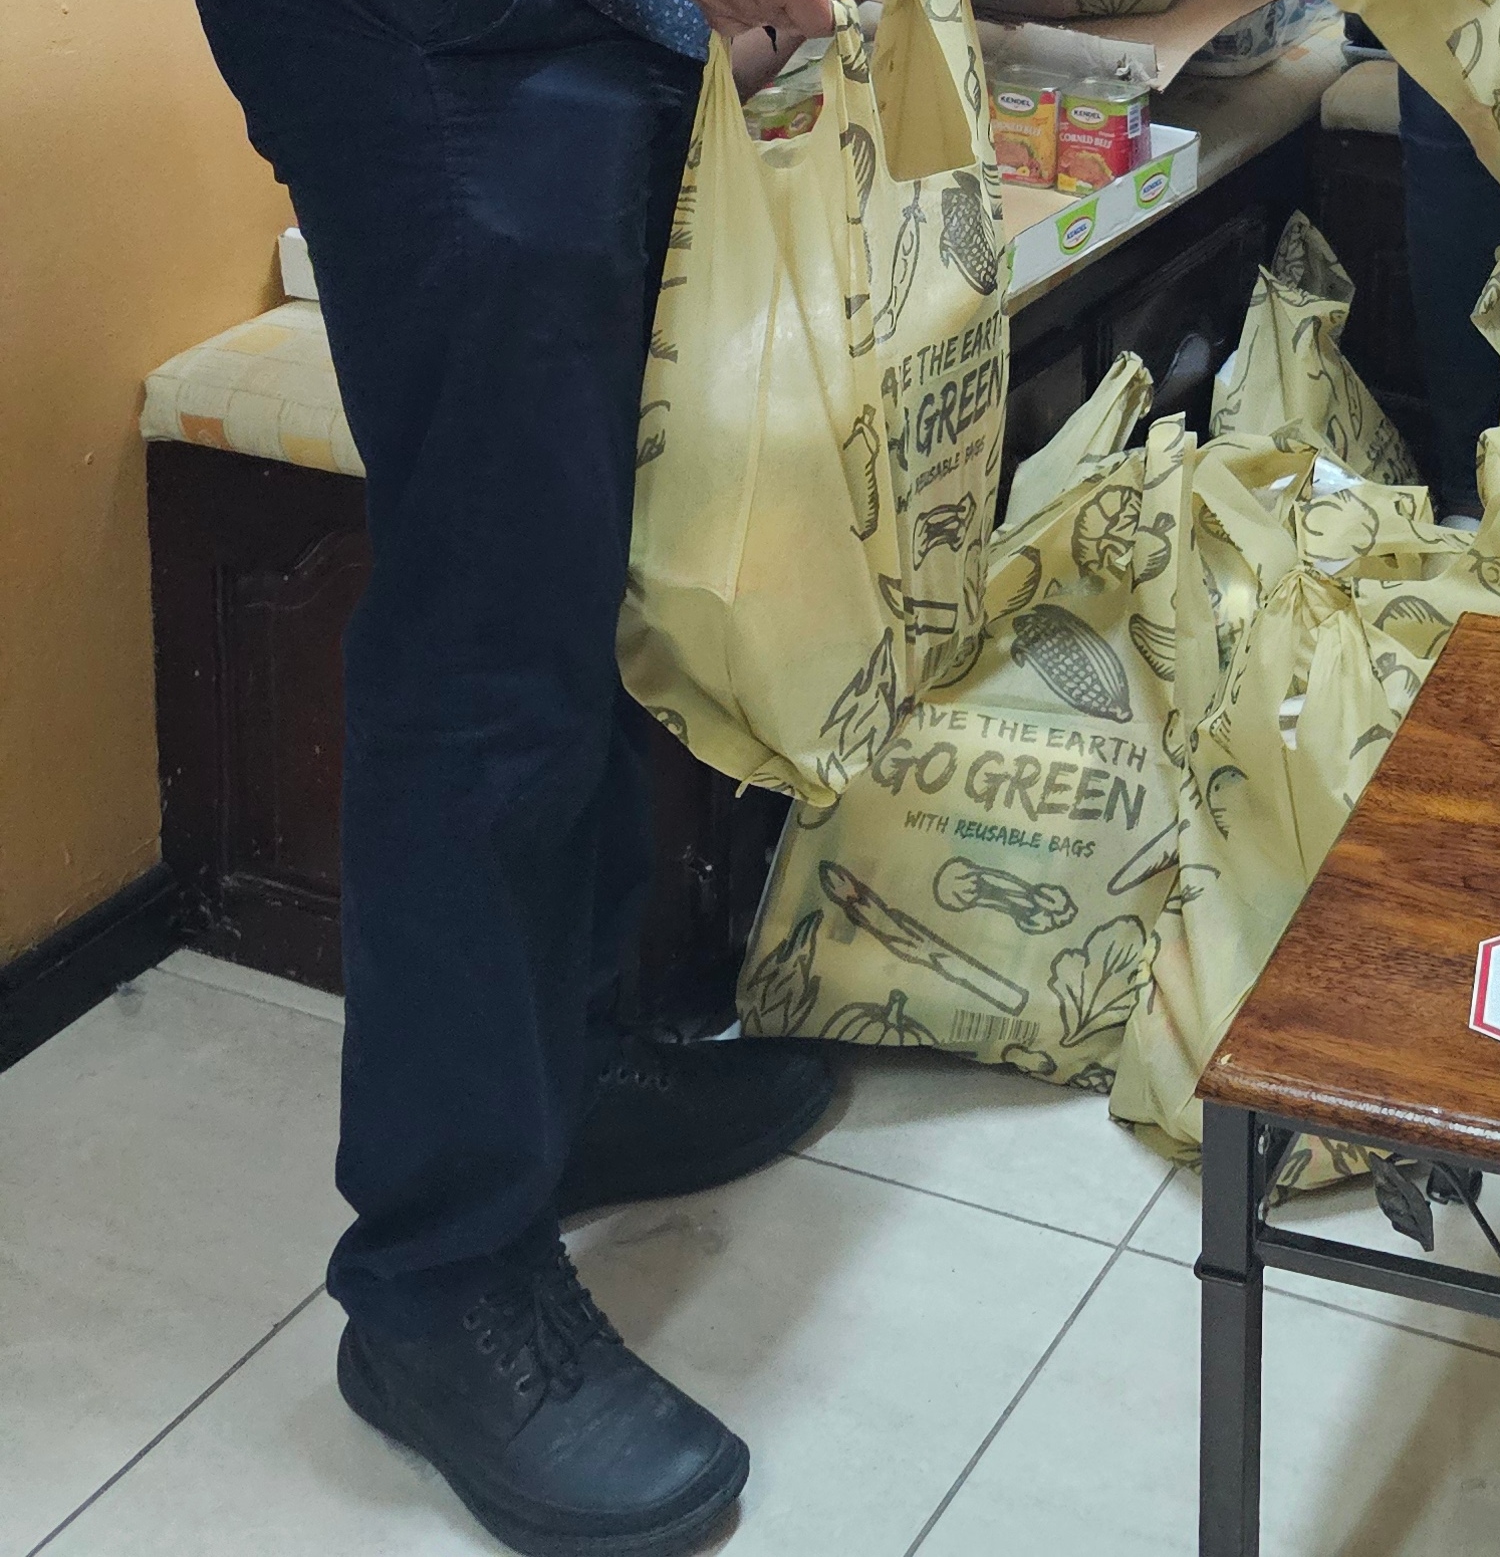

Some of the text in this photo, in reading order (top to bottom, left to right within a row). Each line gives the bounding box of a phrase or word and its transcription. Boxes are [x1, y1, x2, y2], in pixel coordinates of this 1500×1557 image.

[1000, 96, 1031, 107] KENDEL
[1073, 110, 1102, 120] KENDEL
[1143, 178, 1163, 194] KENDEL
[917, 335, 959, 386] THE
[916, 355, 1002, 457] GREEN
[912, 702, 1148, 773] AVE THE EARTH
[871, 738, 1147, 831] GO GREEN
[904, 810, 1095, 859] WITH REUSABLE BAGS
